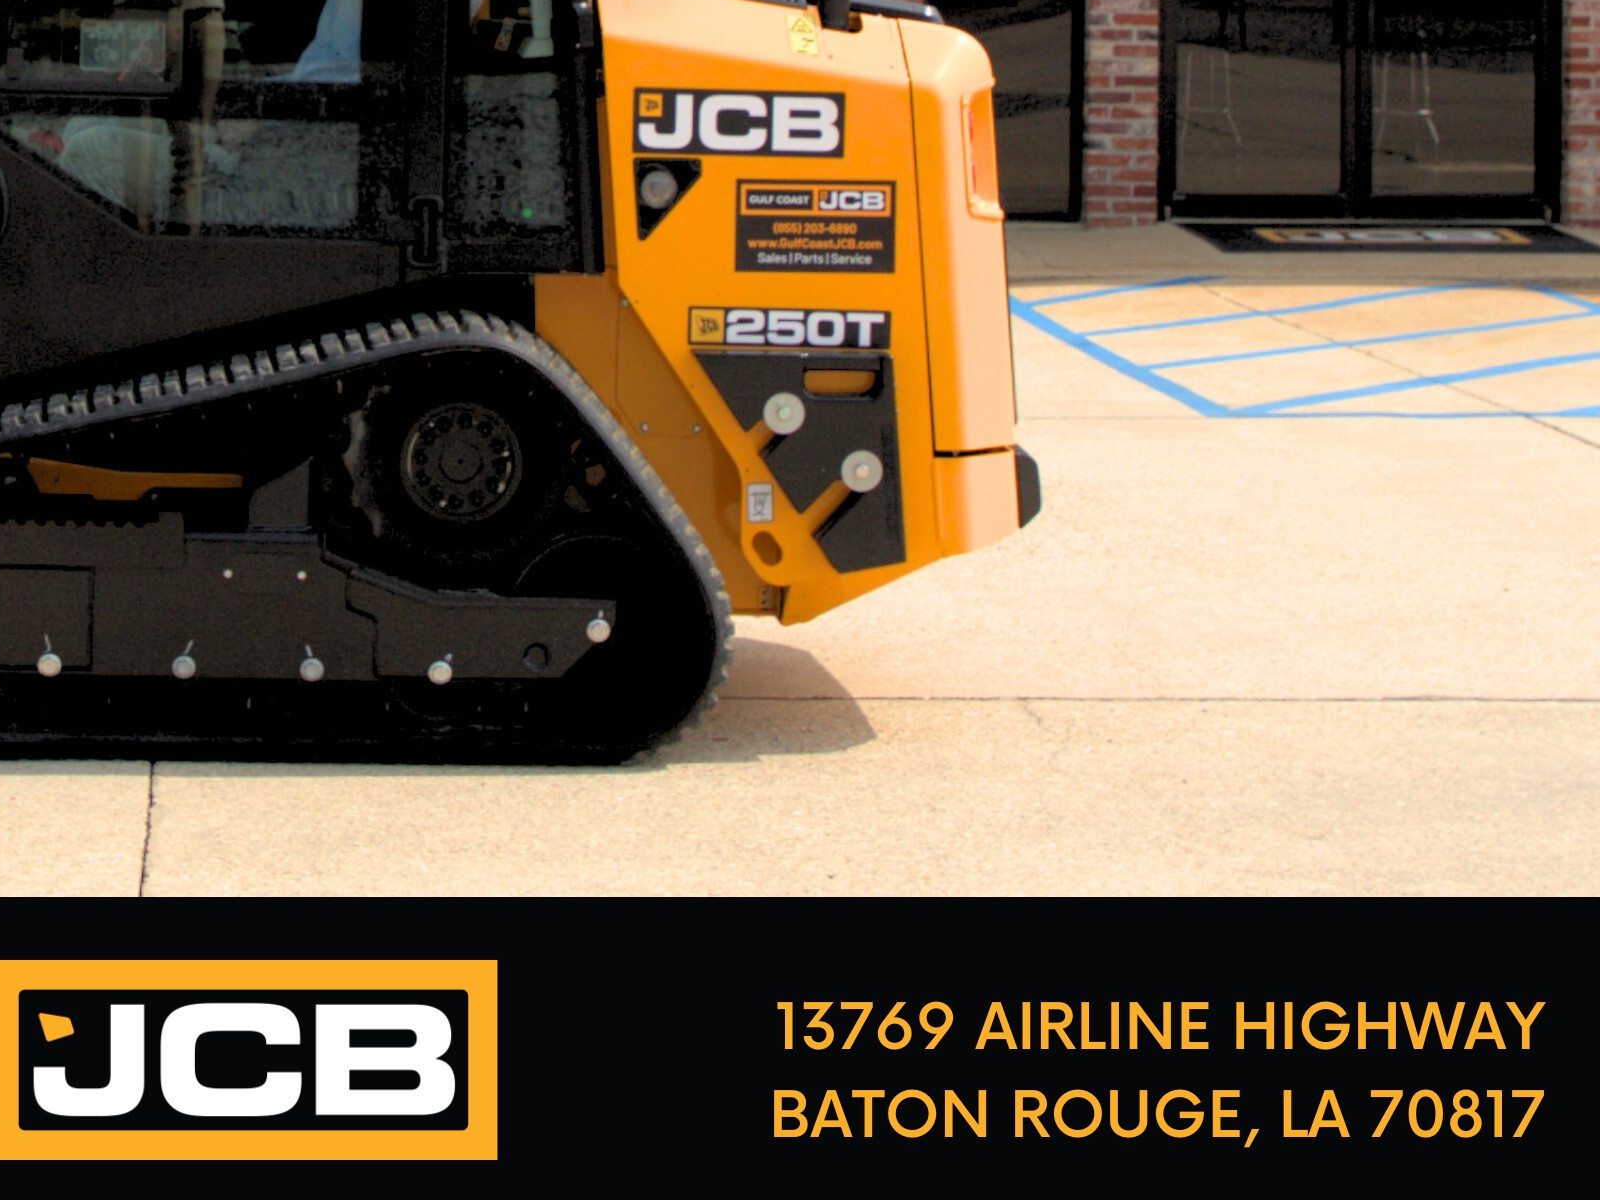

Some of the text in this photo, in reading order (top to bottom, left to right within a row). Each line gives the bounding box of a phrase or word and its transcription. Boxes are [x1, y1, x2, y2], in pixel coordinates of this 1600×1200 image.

[638, 93, 840, 153] JCB
[749, 190, 885, 211] GULF COAST JCB
[726, 309, 885, 347] 250T
